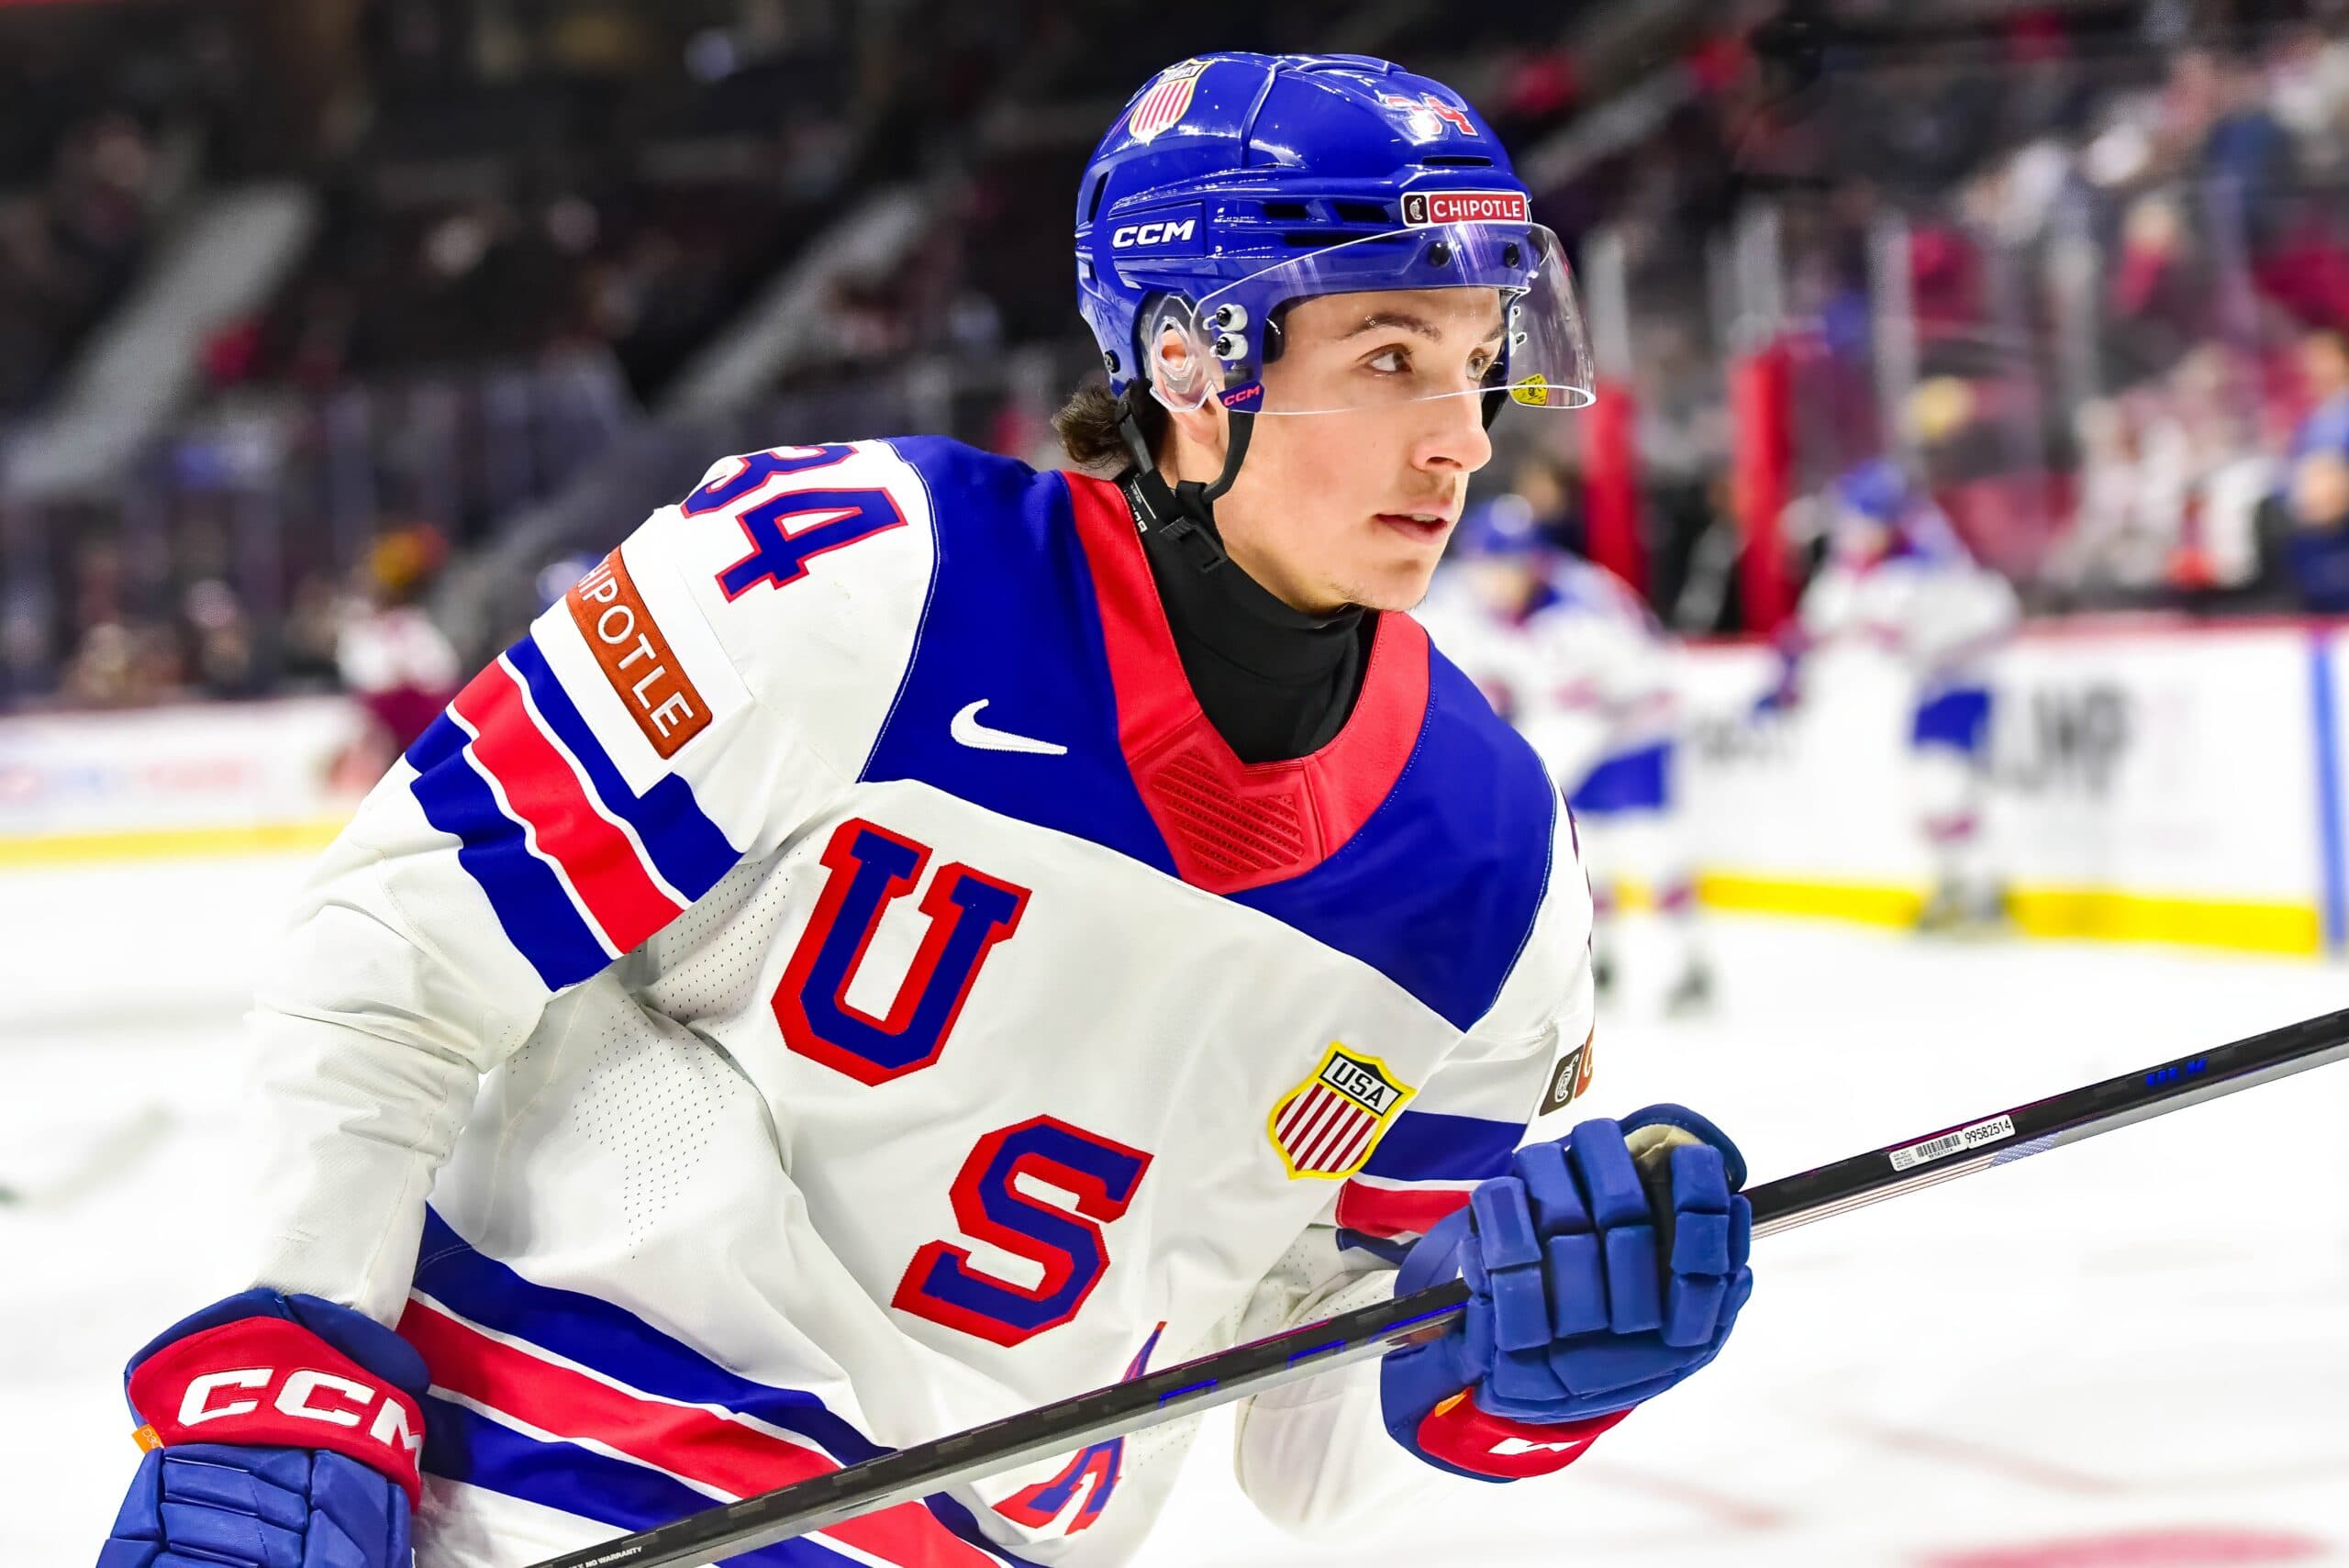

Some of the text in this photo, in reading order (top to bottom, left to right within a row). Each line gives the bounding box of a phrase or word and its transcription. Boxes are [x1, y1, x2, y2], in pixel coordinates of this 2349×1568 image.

[1433, 199, 1522, 217] CHIPOTLE
[1112, 219, 1196, 249] CCM
[1224, 385, 1260, 406] CCM
[681, 444, 908, 603] 34
[578, 554, 695, 739] HIPOTLE
[1332, 1062, 1385, 1106] USA
[1965, 1119, 2011, 1143] 99582514
[178, 1369, 423, 1474] CCM
[585, 1546, 642, 1568] NO WARRANTY
